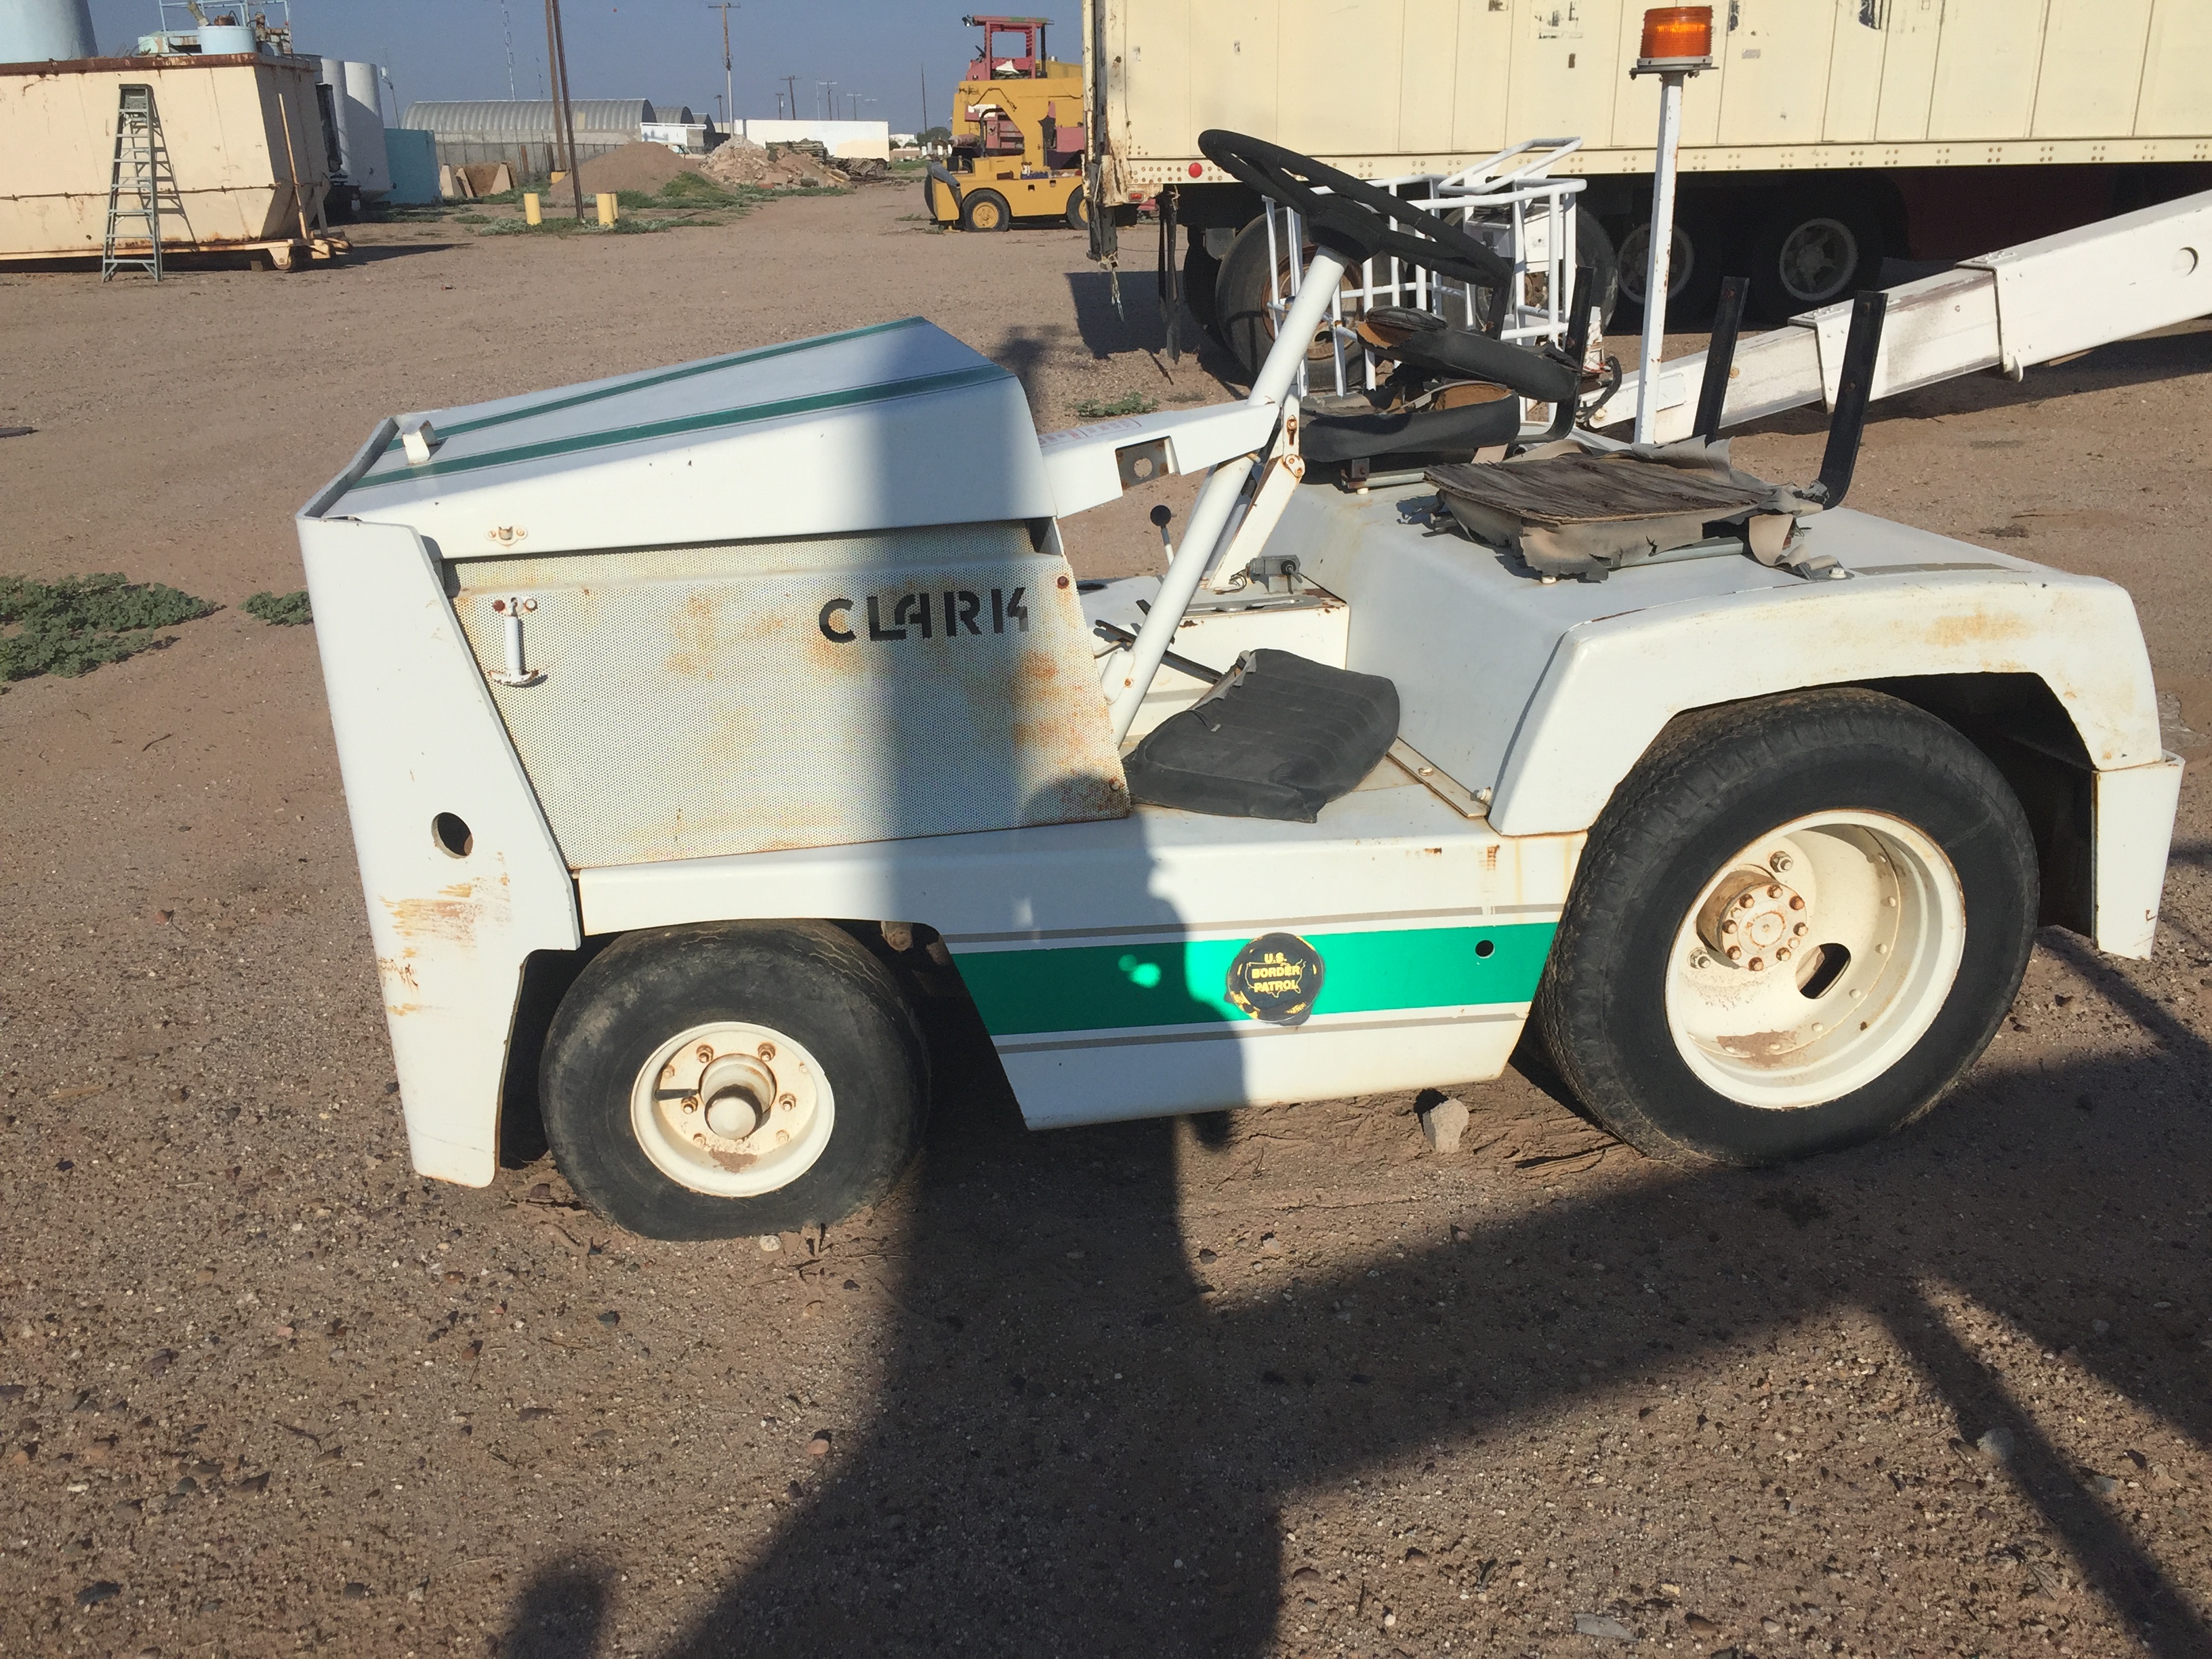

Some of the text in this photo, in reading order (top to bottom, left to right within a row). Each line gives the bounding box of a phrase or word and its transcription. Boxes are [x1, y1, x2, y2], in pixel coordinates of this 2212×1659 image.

[819, 587, 1029, 643] CLARK
[1264, 952, 1287, 964] U.S.
[1251, 965, 1300, 979] BORDER
[1254, 980, 1298, 993] PATROL
